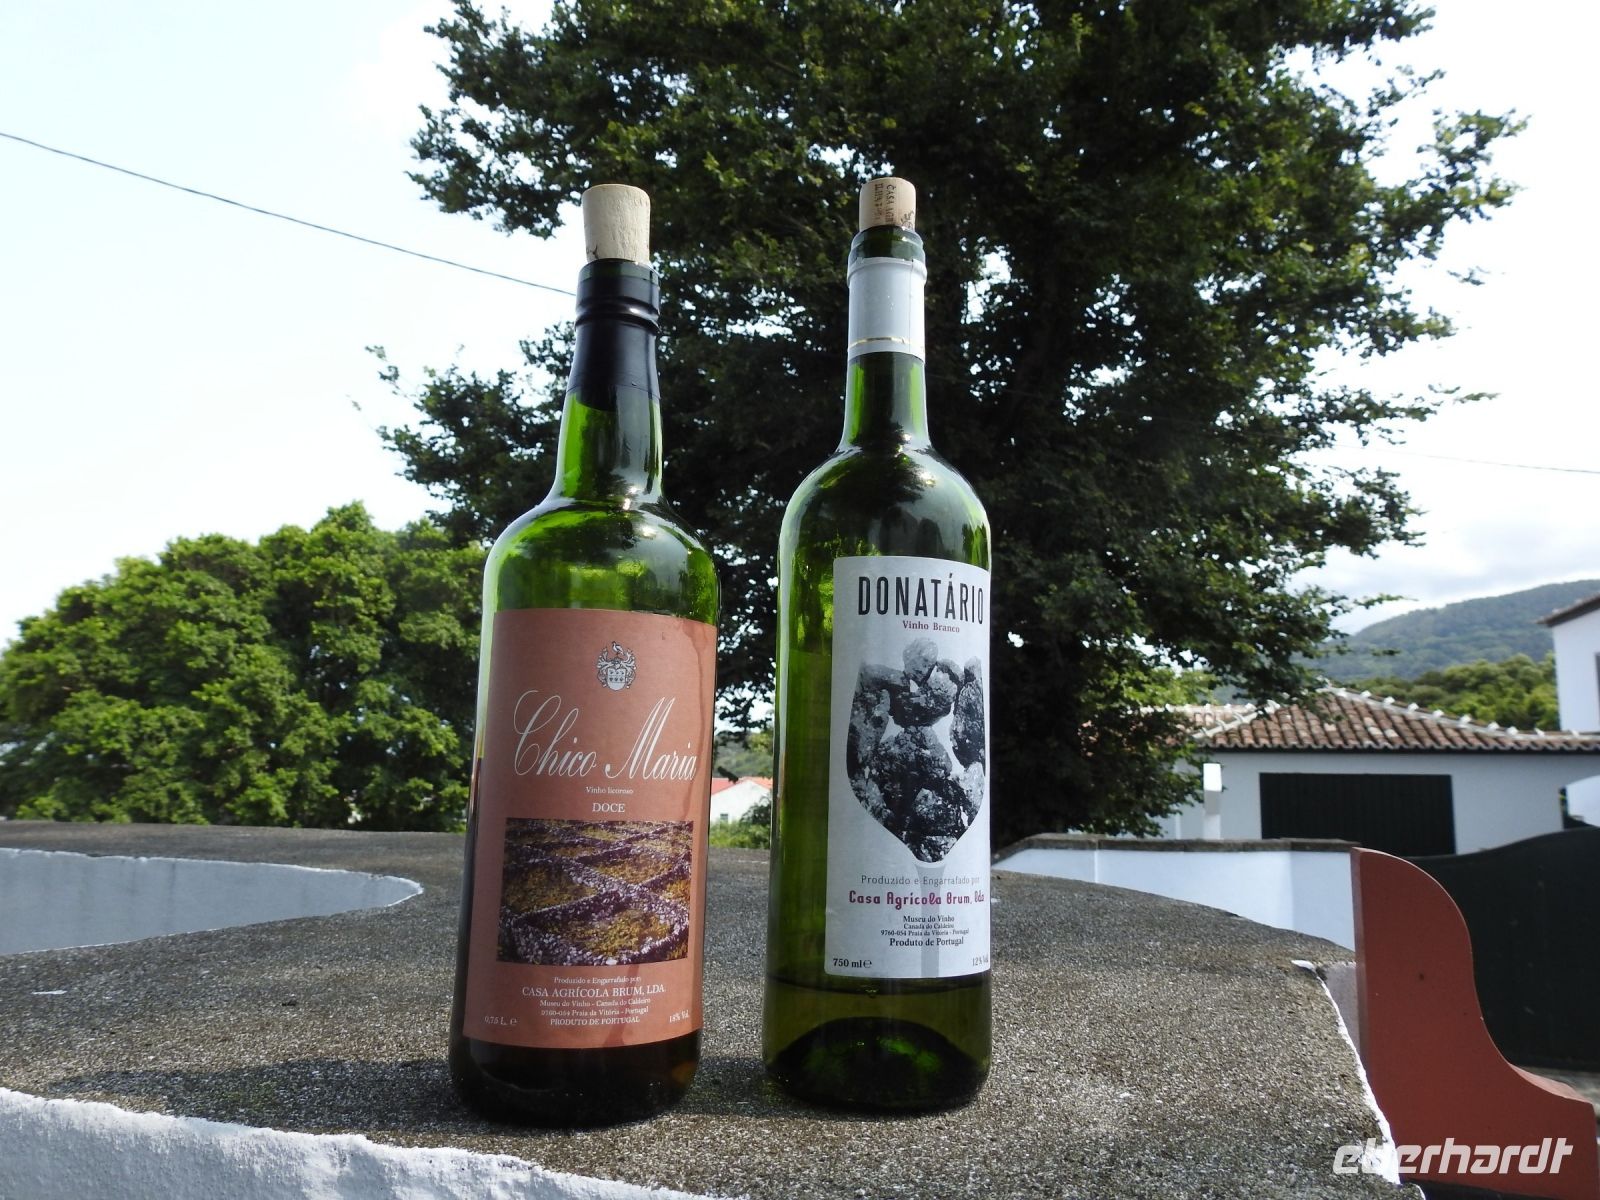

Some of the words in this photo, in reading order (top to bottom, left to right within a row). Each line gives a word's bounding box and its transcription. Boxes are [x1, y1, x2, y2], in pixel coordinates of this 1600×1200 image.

[857, 573, 984, 625] DONATÁRIO
[902, 620, 929, 630] Vinho
[933, 622, 960, 633] Branco
[514, 690, 597, 777] Chico
[605, 696, 698, 781] Maria
[585, 786, 606, 794] Vinho
[592, 802, 626, 813] DOCE
[861, 874, 911, 885] Produzido
[922, 875, 970, 888] Engarrafado
[849, 890, 881, 904] Casa
[886, 889, 942, 910] Agrícola
[903, 915, 926, 923] Museu
[927, 915, 936, 923] do
[889, 937, 923, 947] Produto
[925, 937, 935, 946] de
[936, 936, 964, 947] Portugal
[833, 958, 849, 968] 750
[554, 976, 586, 984] Produzido
[522, 987, 549, 998] CASA
[551, 986, 609, 998] AGRÍCOLA
[612, 986, 645, 997] BRUM,
[625, 1006, 649, 1015] Portugal
[550, 1018, 588, 1026] PRODUTO
[601, 1016, 641, 1025] PORTUGAL
